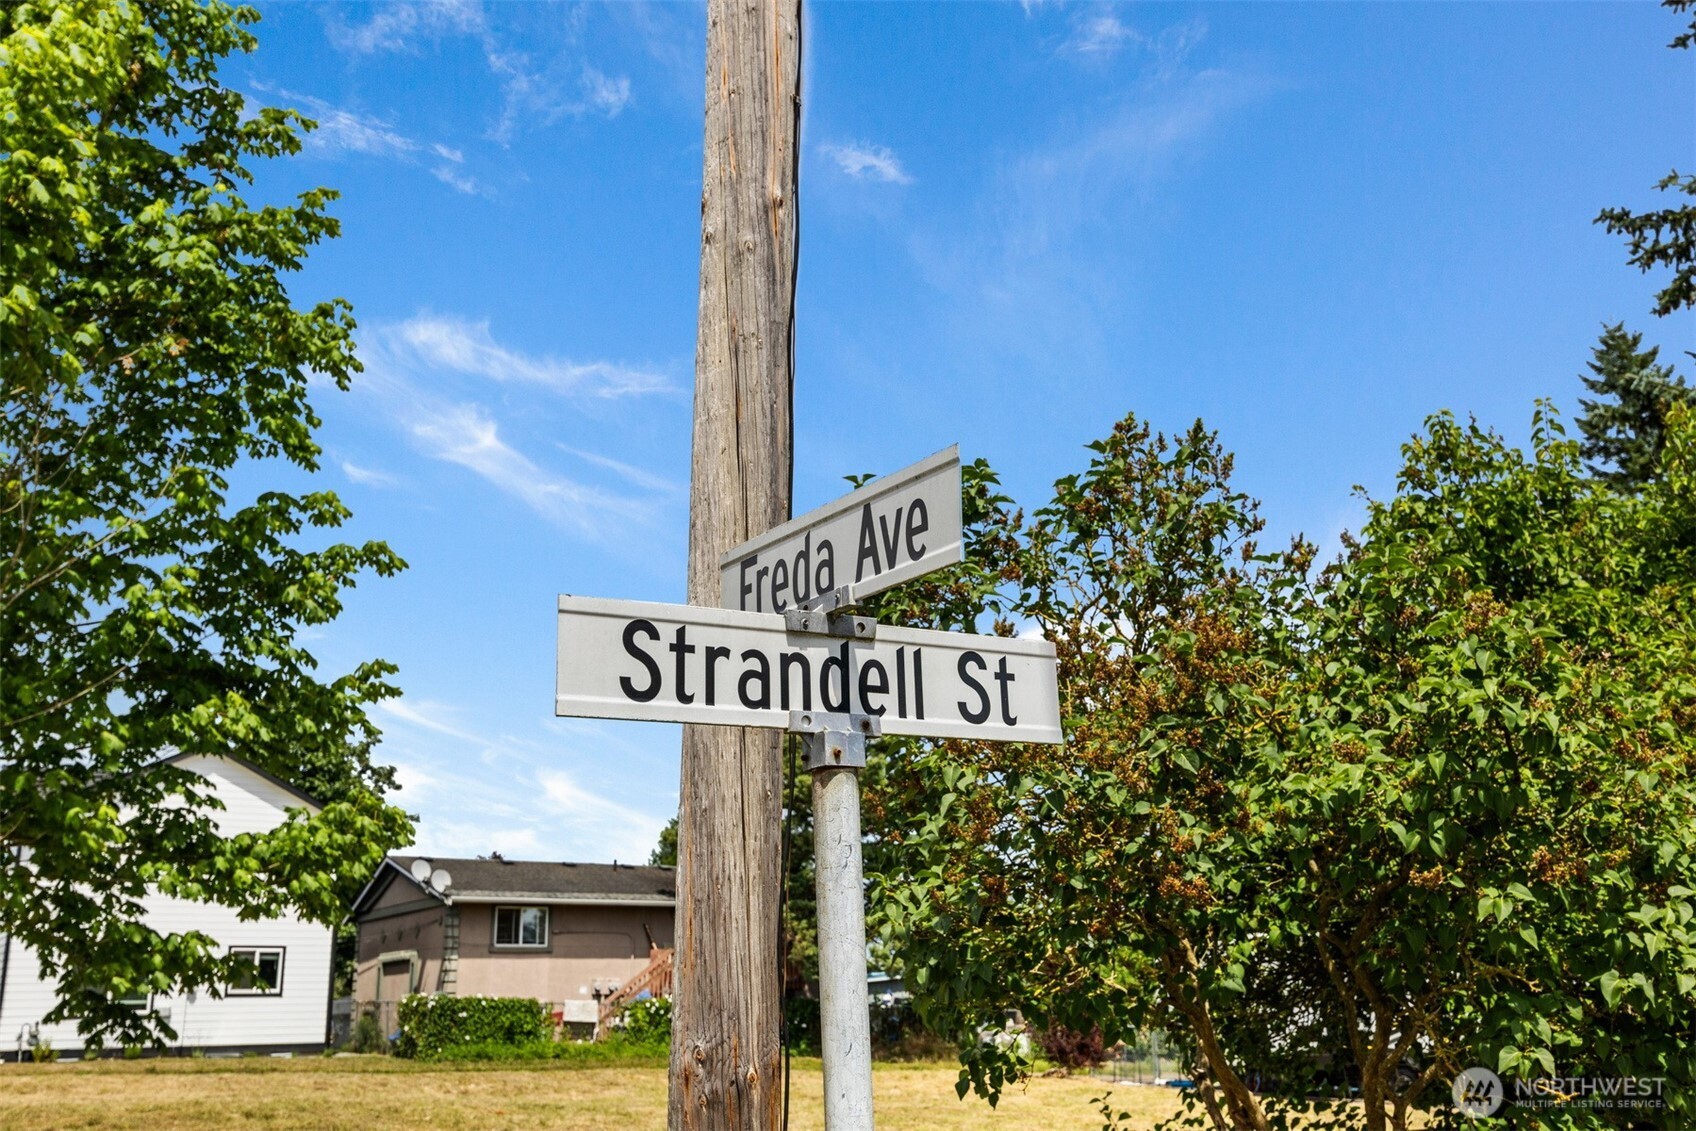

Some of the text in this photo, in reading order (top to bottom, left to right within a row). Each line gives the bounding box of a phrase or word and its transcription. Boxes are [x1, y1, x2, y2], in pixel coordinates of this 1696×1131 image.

[740, 498, 929, 613] Freda Ave
[619, 618, 1018, 726] Strandell St
